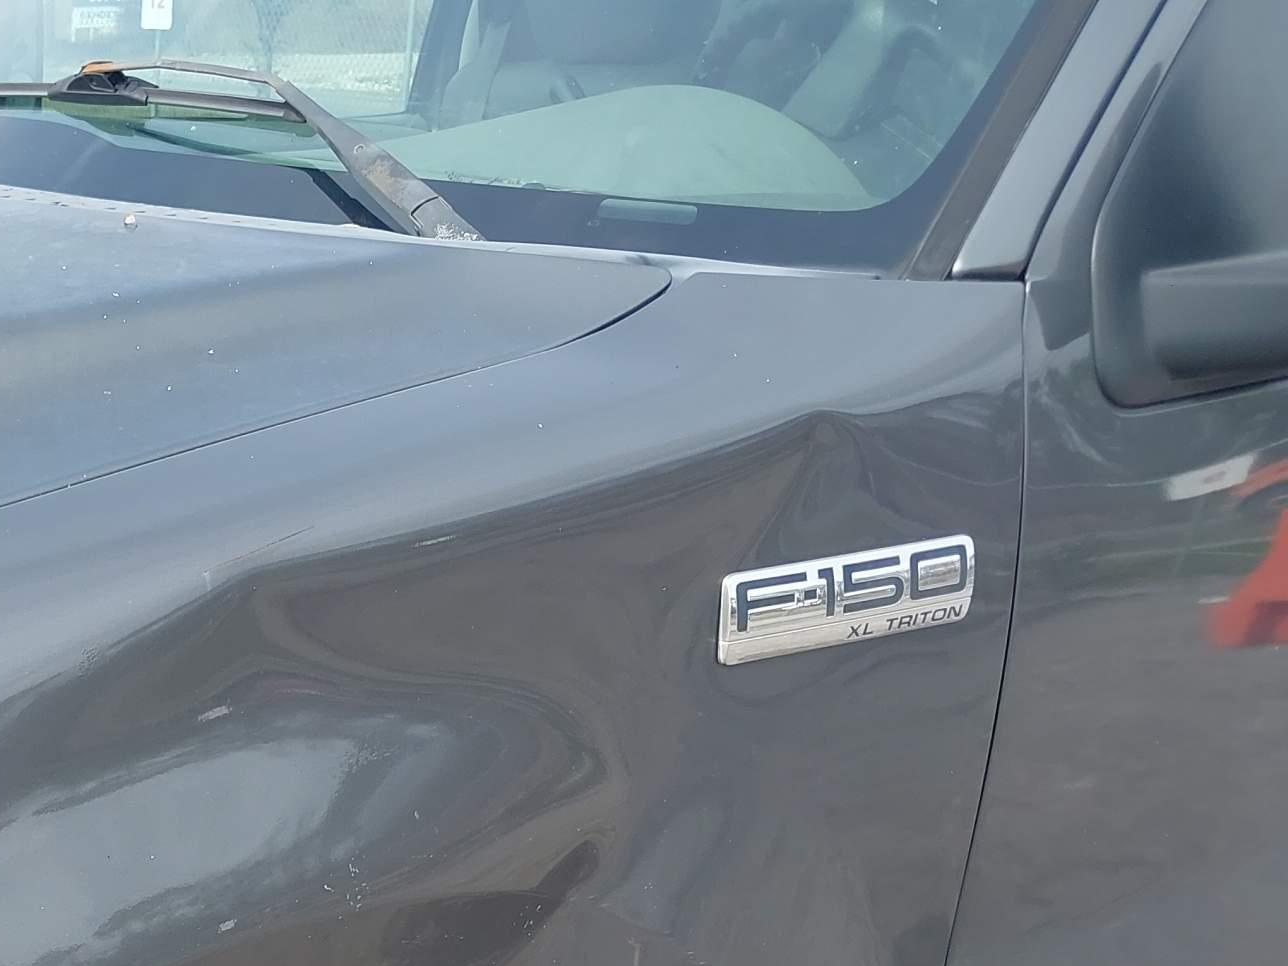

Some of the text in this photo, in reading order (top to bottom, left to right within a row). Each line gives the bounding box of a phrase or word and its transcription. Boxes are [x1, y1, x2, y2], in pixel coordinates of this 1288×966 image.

[736, 544, 968, 633] F-150
[846, 603, 964, 639] XL TRITON
